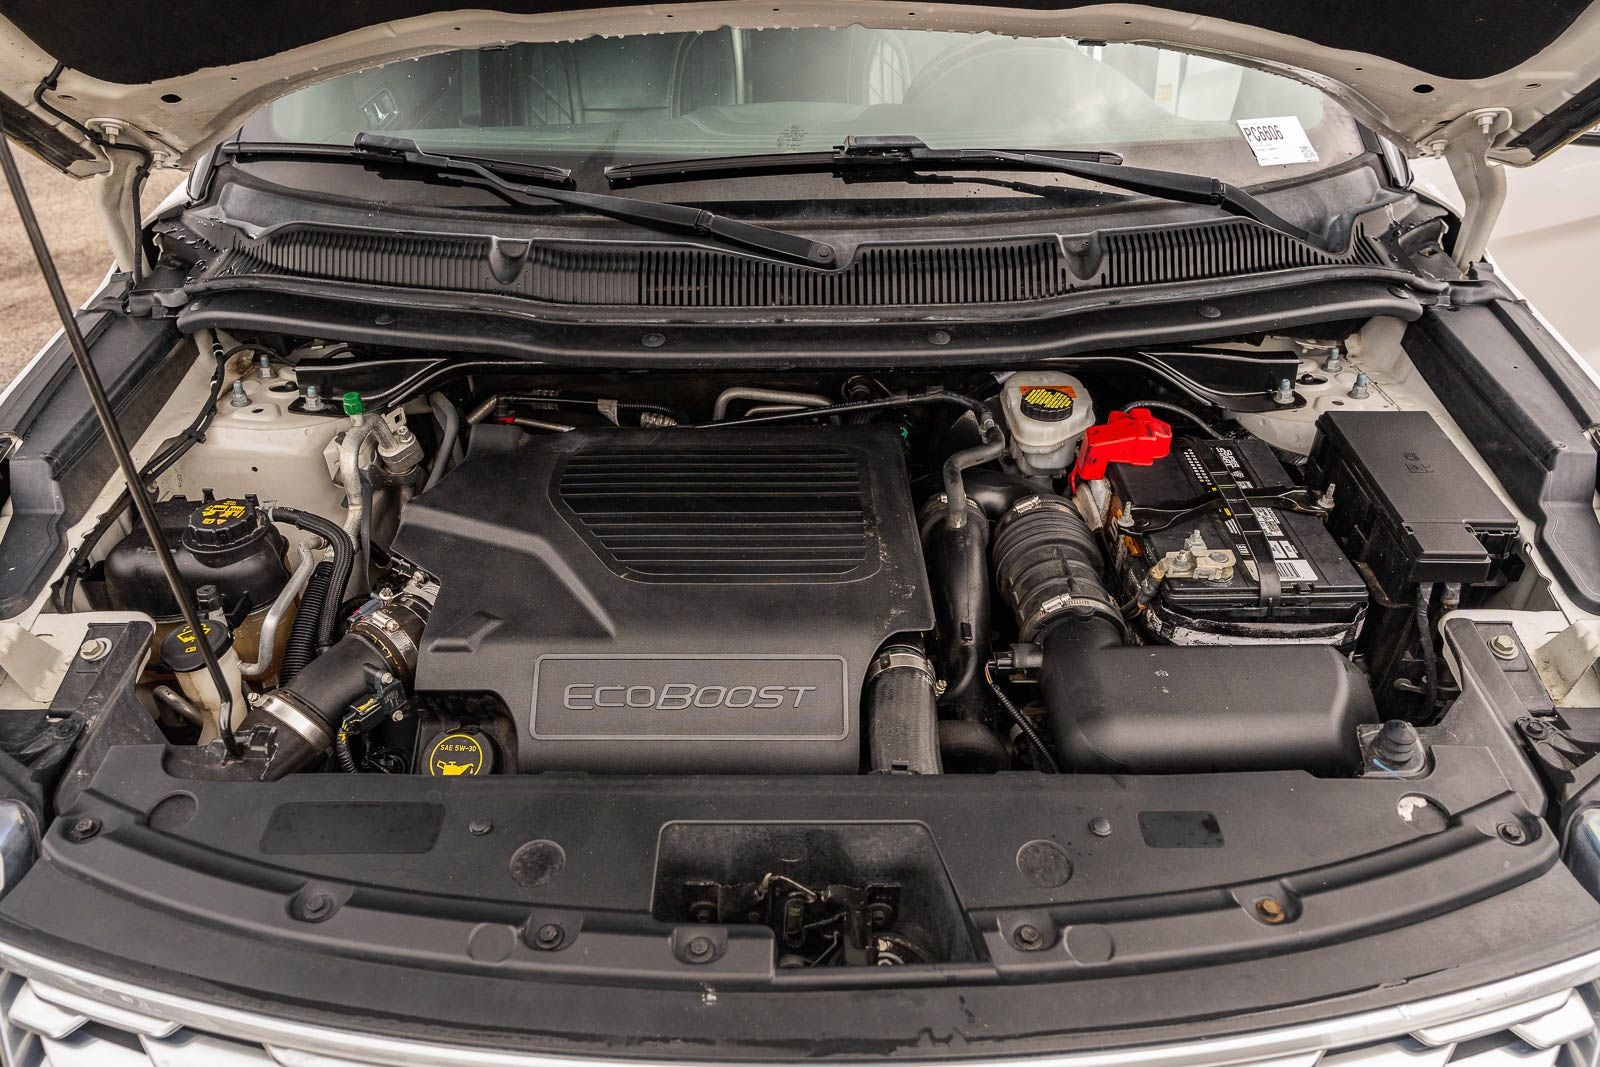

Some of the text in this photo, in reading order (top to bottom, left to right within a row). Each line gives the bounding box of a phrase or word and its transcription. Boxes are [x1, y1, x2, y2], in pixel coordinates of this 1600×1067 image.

[1243, 124, 1284, 142] PC6606
[1215, 447, 1231, 467] START
[440, 744, 477, 752] SAE 5W-30
